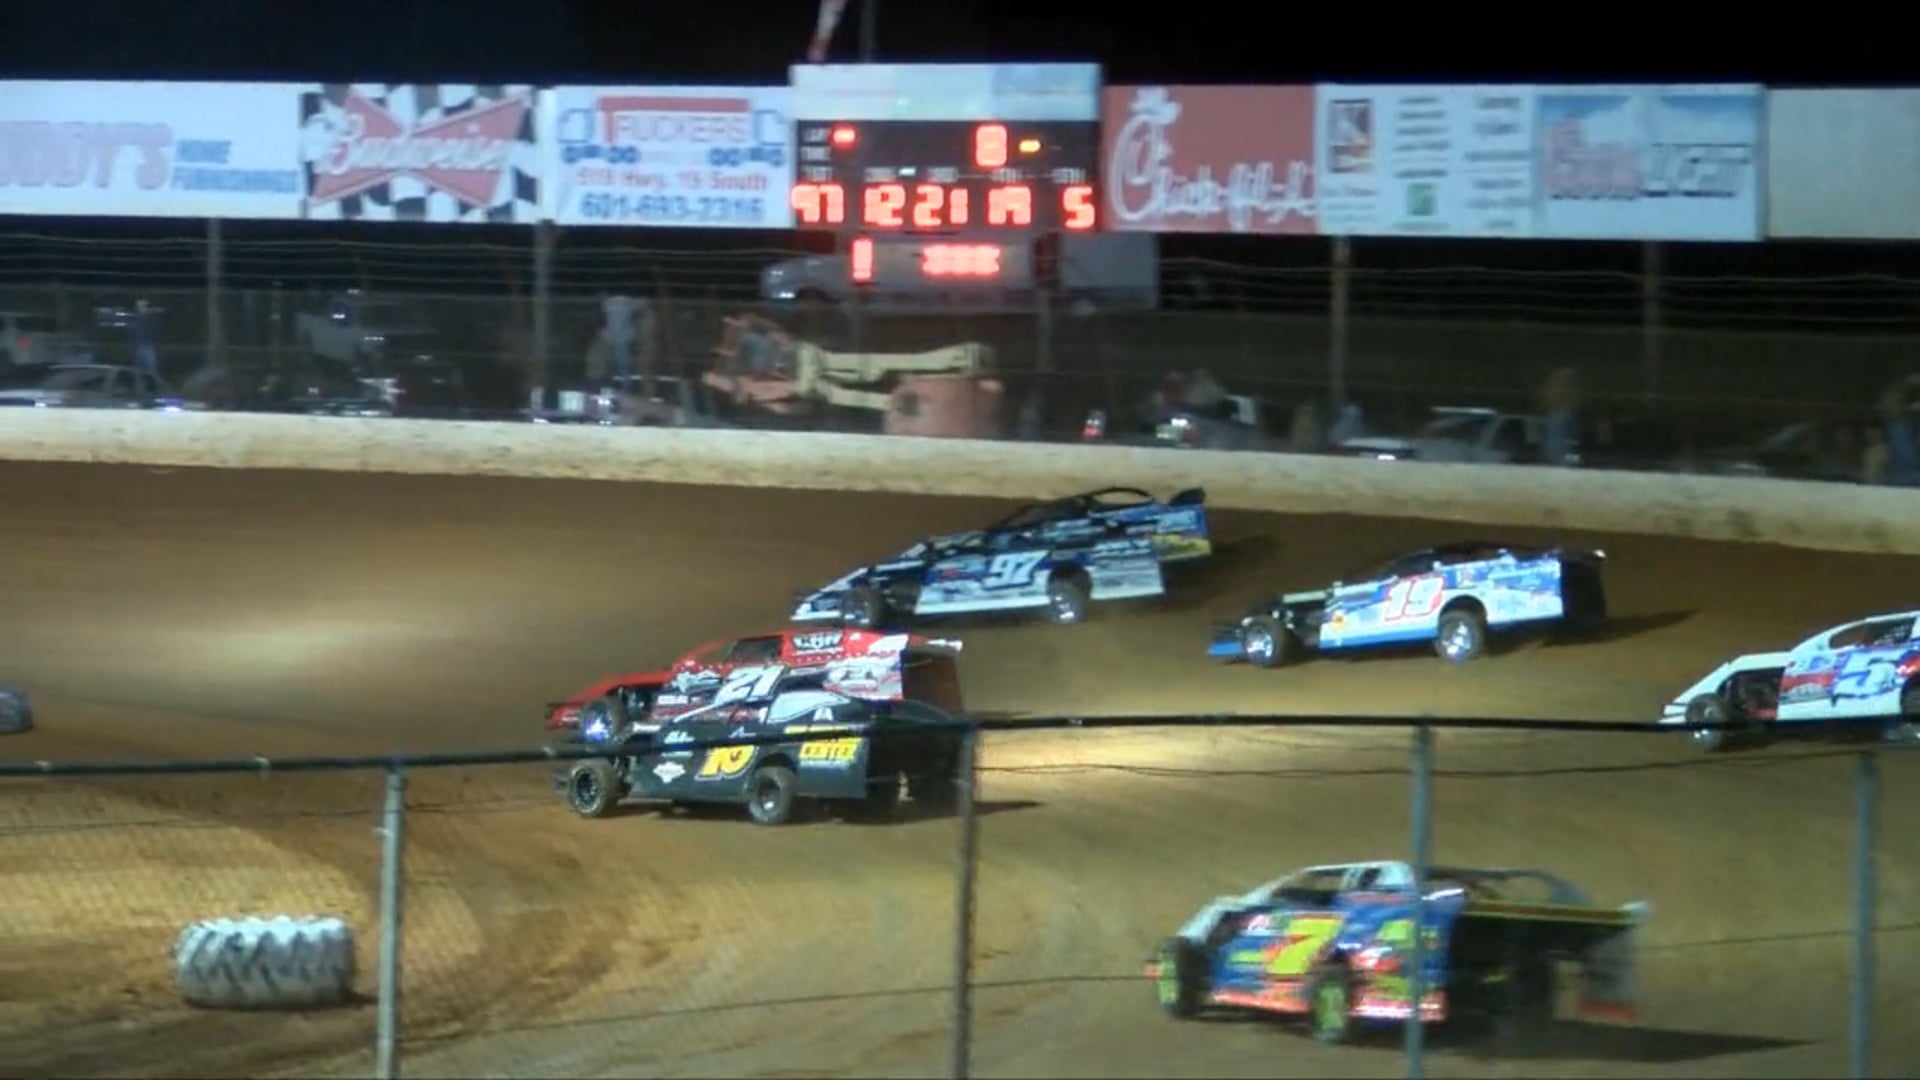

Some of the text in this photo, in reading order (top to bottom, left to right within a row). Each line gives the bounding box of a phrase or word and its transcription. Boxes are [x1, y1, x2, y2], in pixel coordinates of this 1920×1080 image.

[913, 185, 969, 227] 21
[1062, 186, 1096, 229] 5
[982, 550, 1049, 588] 97
[1384, 574, 1446, 622] 19
[714, 664, 784, 706] 21
[1266, 914, 1343, 976] 7
